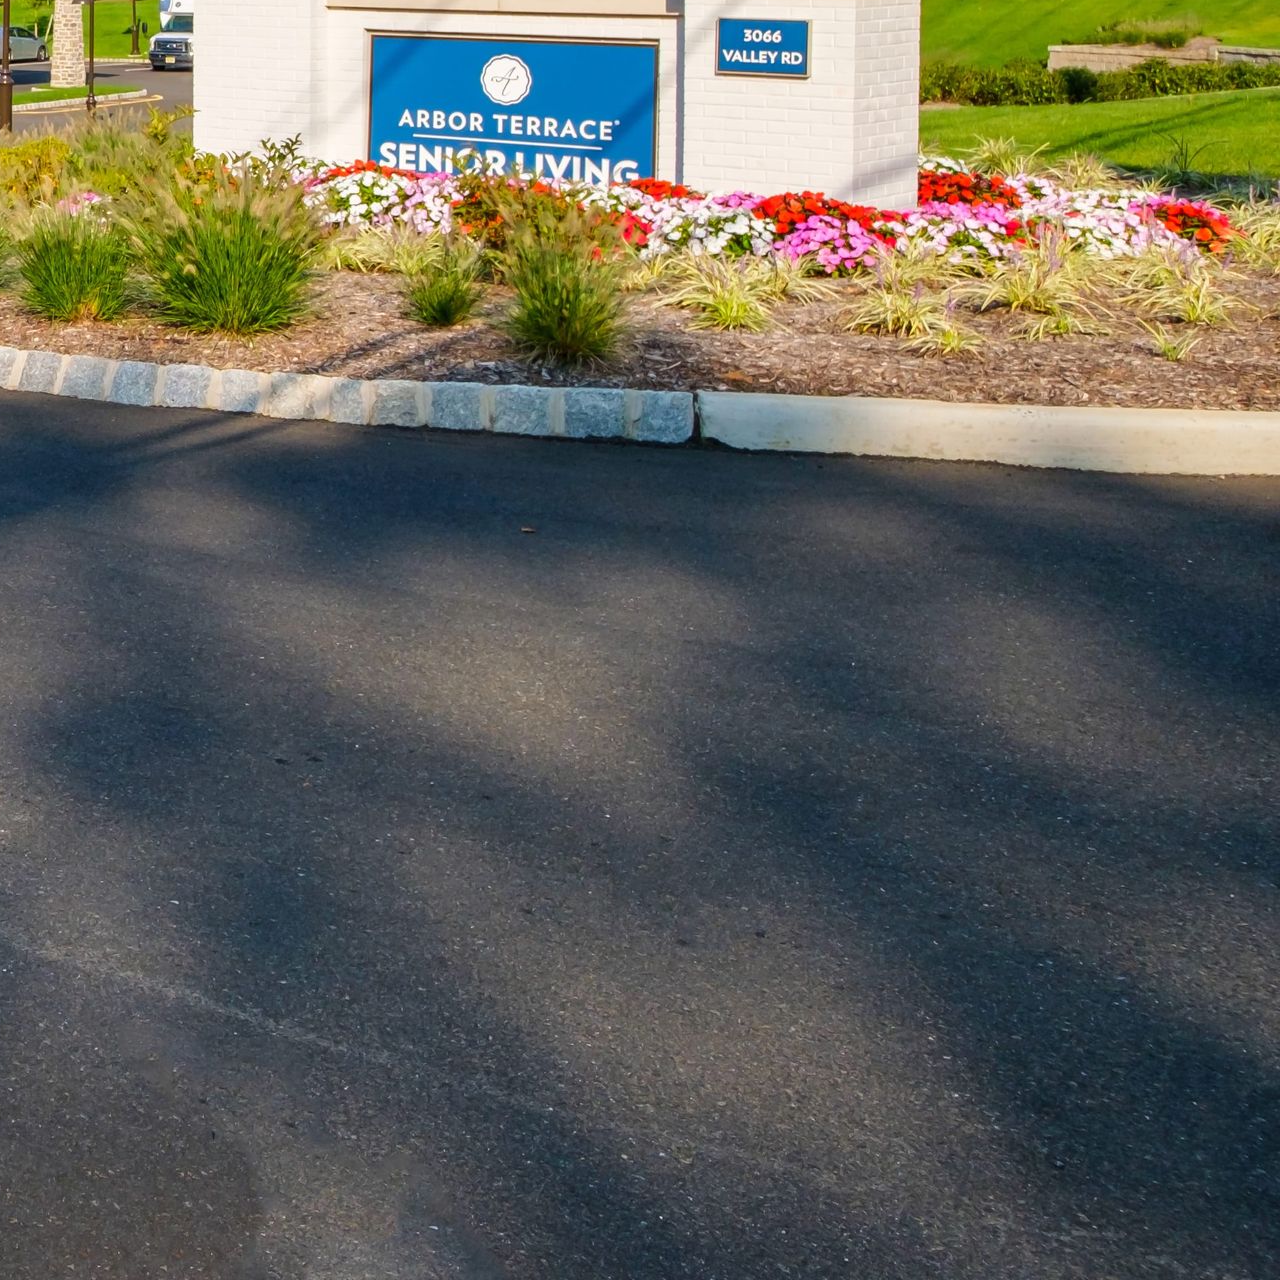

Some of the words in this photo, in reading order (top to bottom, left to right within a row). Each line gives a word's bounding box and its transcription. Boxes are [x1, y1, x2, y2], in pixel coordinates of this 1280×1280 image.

[743, 29, 782, 44] 3066
[722, 49, 778, 65] VALLEY
[781, 51, 803, 65] RD
[398, 108, 484, 132] ARBOR
[493, 114, 613, 141] TERRACE
[378, 141, 506, 176] SENIOR
[515, 151, 640, 186] LIVING
